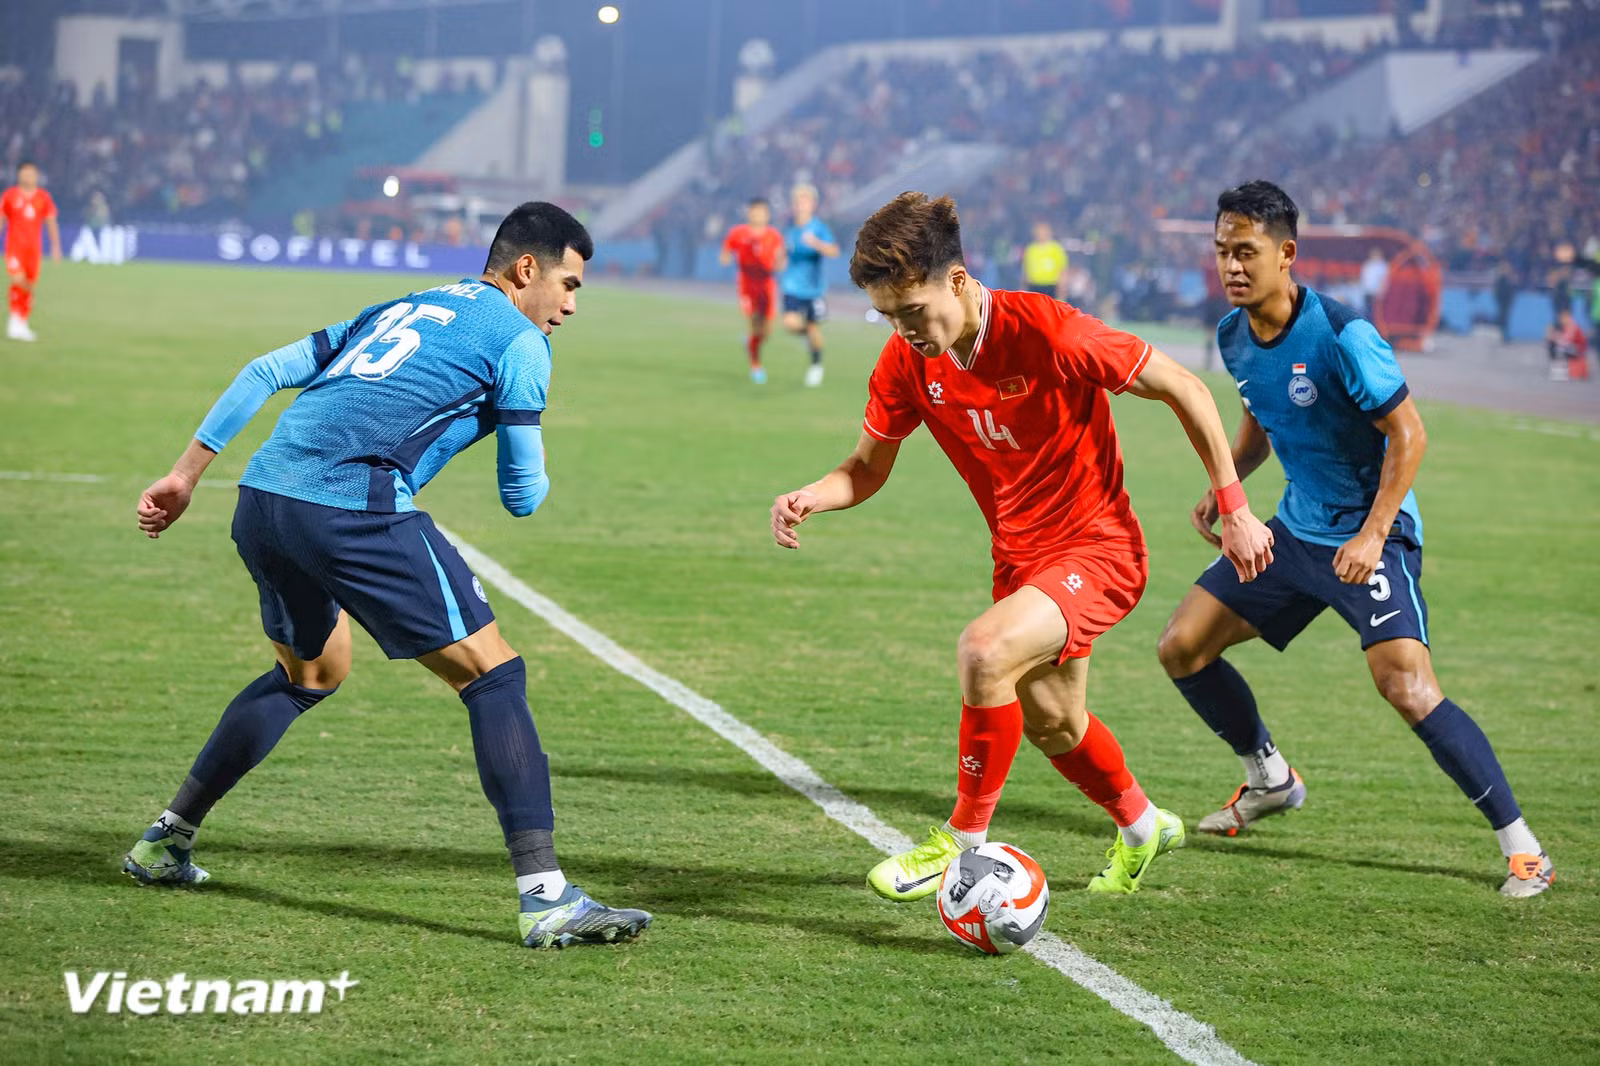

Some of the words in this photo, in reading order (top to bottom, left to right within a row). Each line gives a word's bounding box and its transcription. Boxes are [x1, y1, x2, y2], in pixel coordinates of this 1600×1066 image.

[217, 232, 430, 268] SOFITEL
[326, 302, 457, 381] 15
[966, 409, 1021, 450] 14
[1368, 560, 1391, 601] 5
